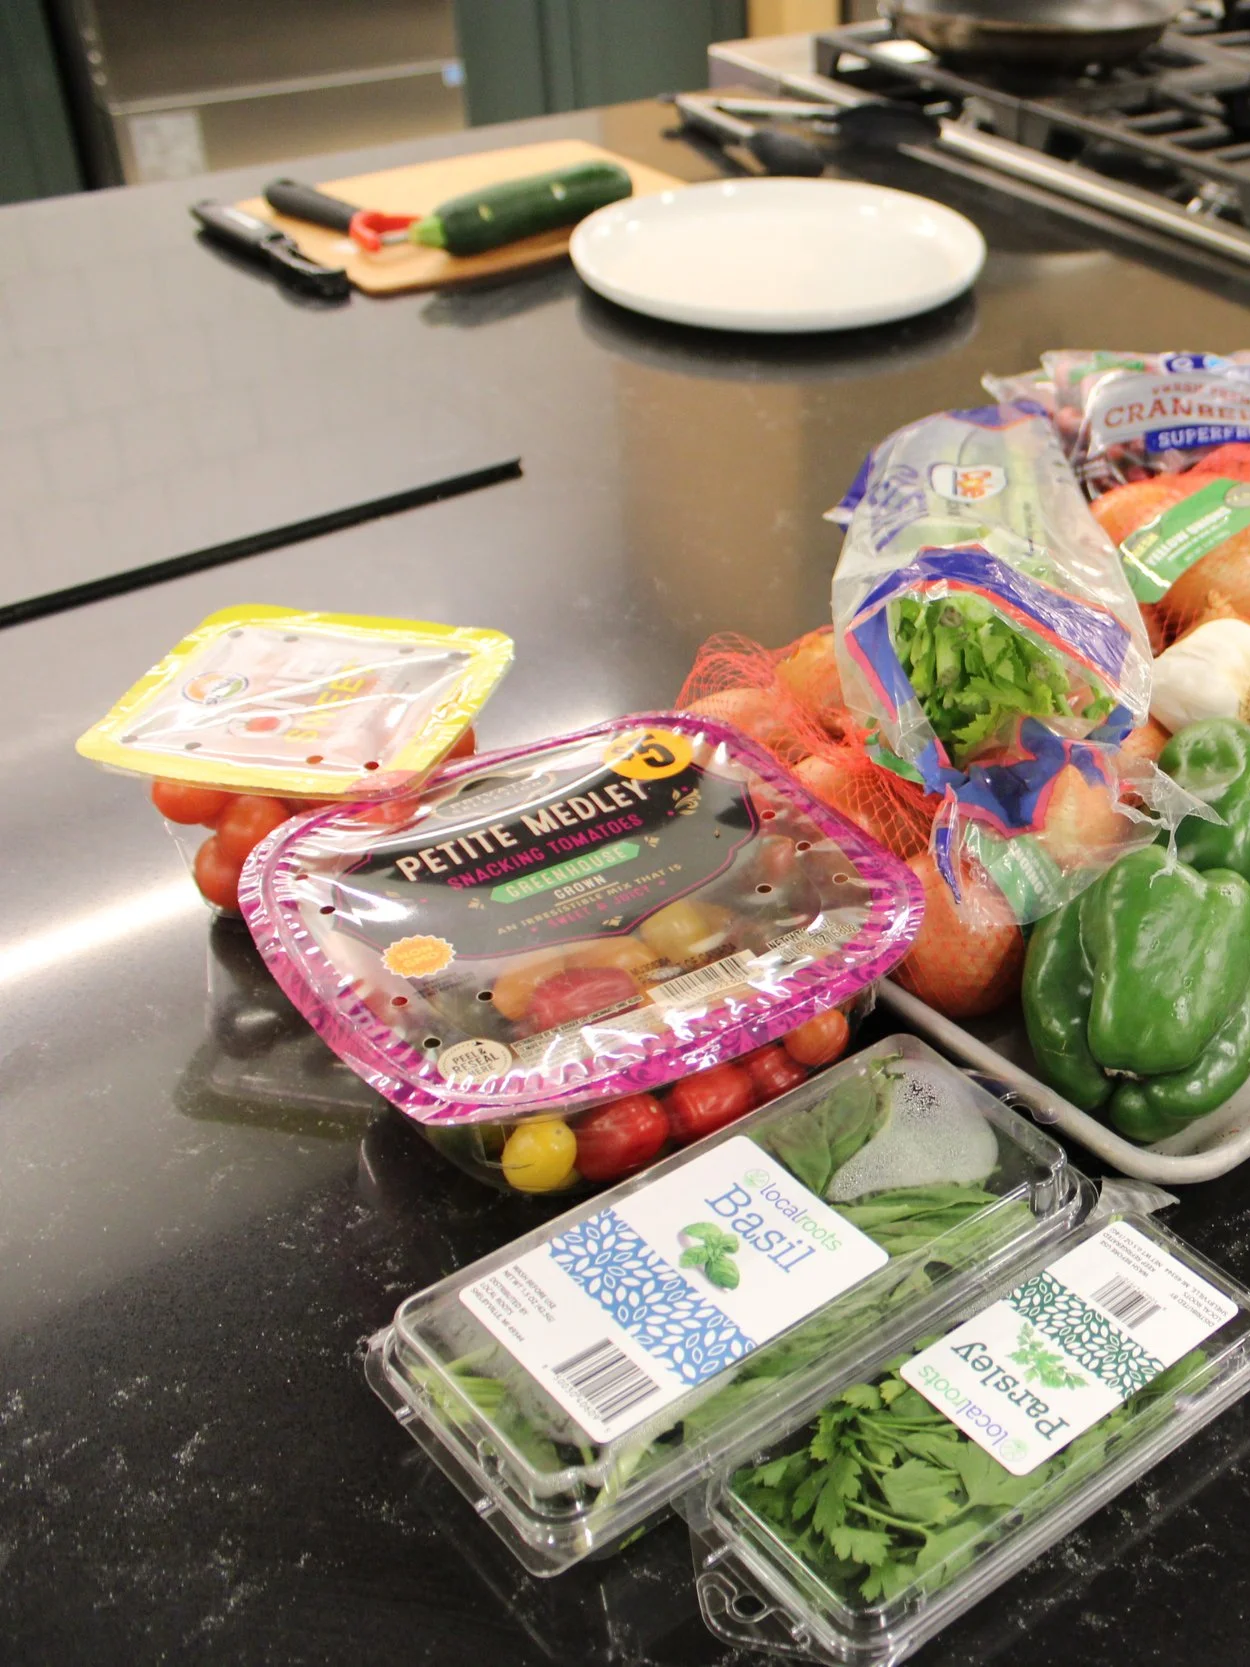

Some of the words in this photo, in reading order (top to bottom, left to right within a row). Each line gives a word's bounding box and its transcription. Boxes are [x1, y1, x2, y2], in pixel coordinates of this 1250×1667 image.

[396, 823, 519, 883] PETITE
[520, 778, 650, 837] MEDLEY
[447, 847, 546, 893] SNACKING
[547, 813, 645, 856] TOMATOES
[497, 924, 518, 936] AN
[521, 894, 604, 927] IRRESISTIBLE
[606, 881, 632, 898] MIX
[634, 869, 666, 884] THAT
[669, 863, 683, 872] IS
[507, 846, 630, 900] GREENHOUSE
[554, 875, 607, 901] GROWN
[452, 1050, 477, 1066] PEEL
[452, 1053, 500, 1075] RESEAL
[704, 1182, 816, 1273] Basil
[760, 1182, 842, 1251] localroots
[918, 1364, 1009, 1447] localroots
[950, 1342, 1071, 1441] Parsley
